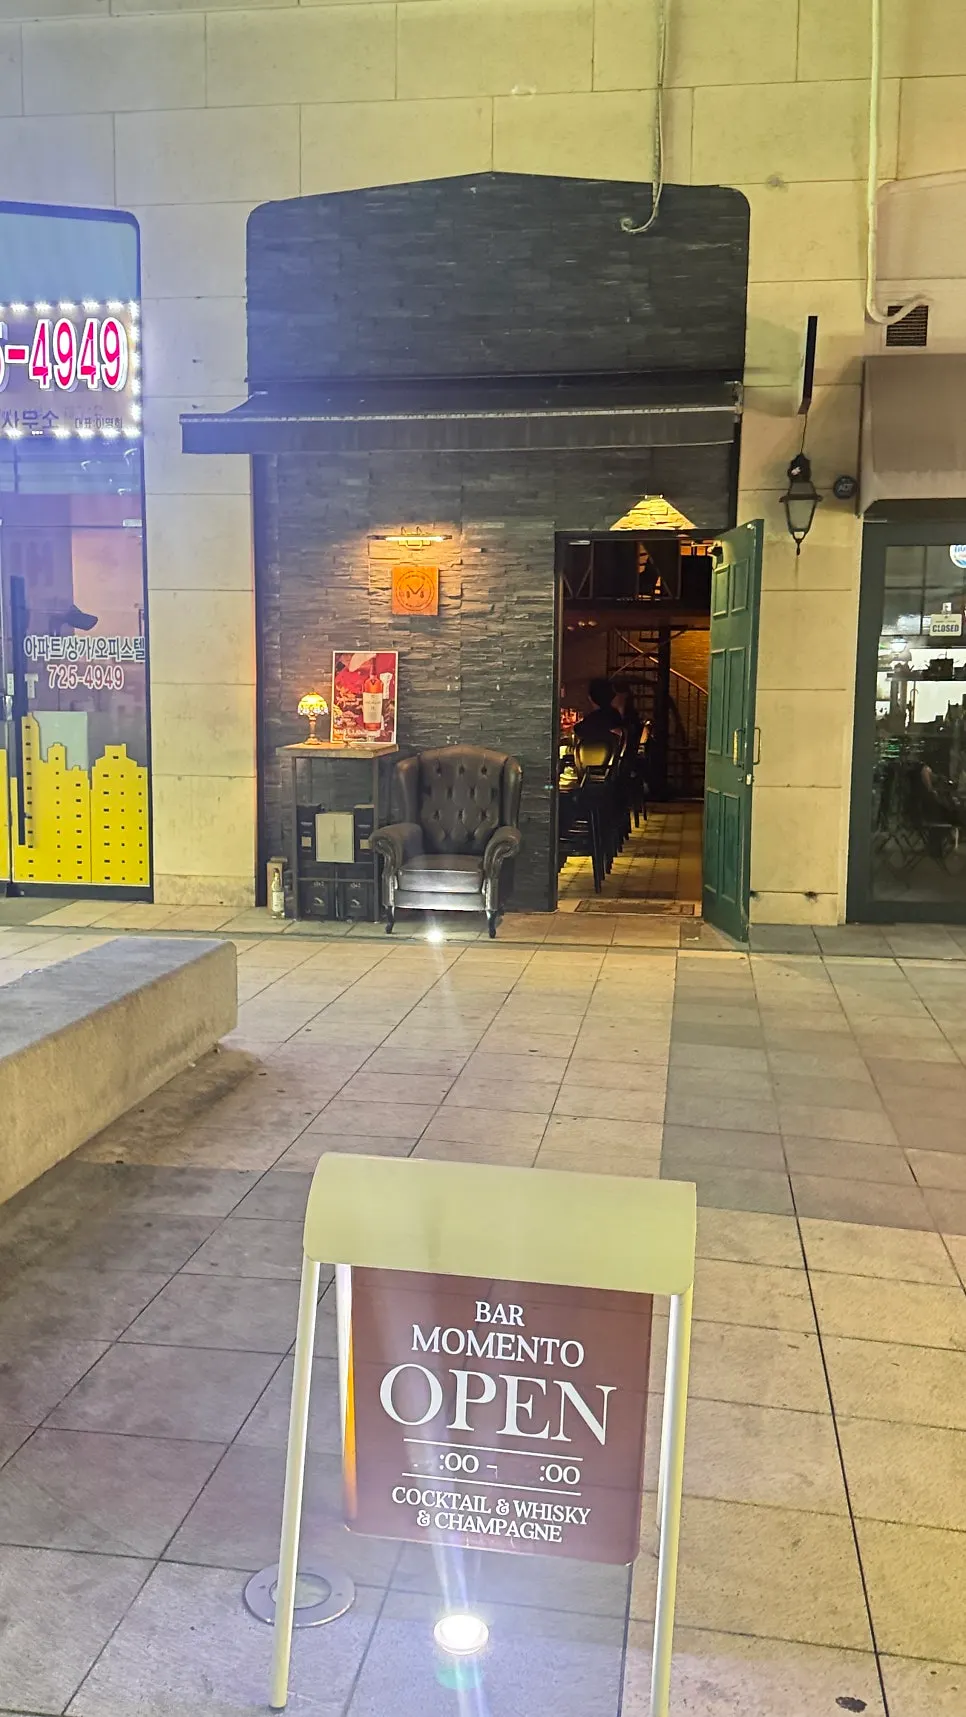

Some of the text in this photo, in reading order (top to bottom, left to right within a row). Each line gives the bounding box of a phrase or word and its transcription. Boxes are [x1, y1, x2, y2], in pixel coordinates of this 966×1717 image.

[0, 317, 128, 391] -4949
[932, 624, 960, 633] CLOSED
[47, 664, 125, 690] 725-4949
[475, 1300, 525, 1327] BAR
[411, 1324, 585, 1368] MOMENTO
[379, 1363, 617, 1446] OPEN
[391, 1486, 591, 1525] COCKTAIL & WHISKY
[416, 1509, 563, 1543] & CHAMPAGNE
